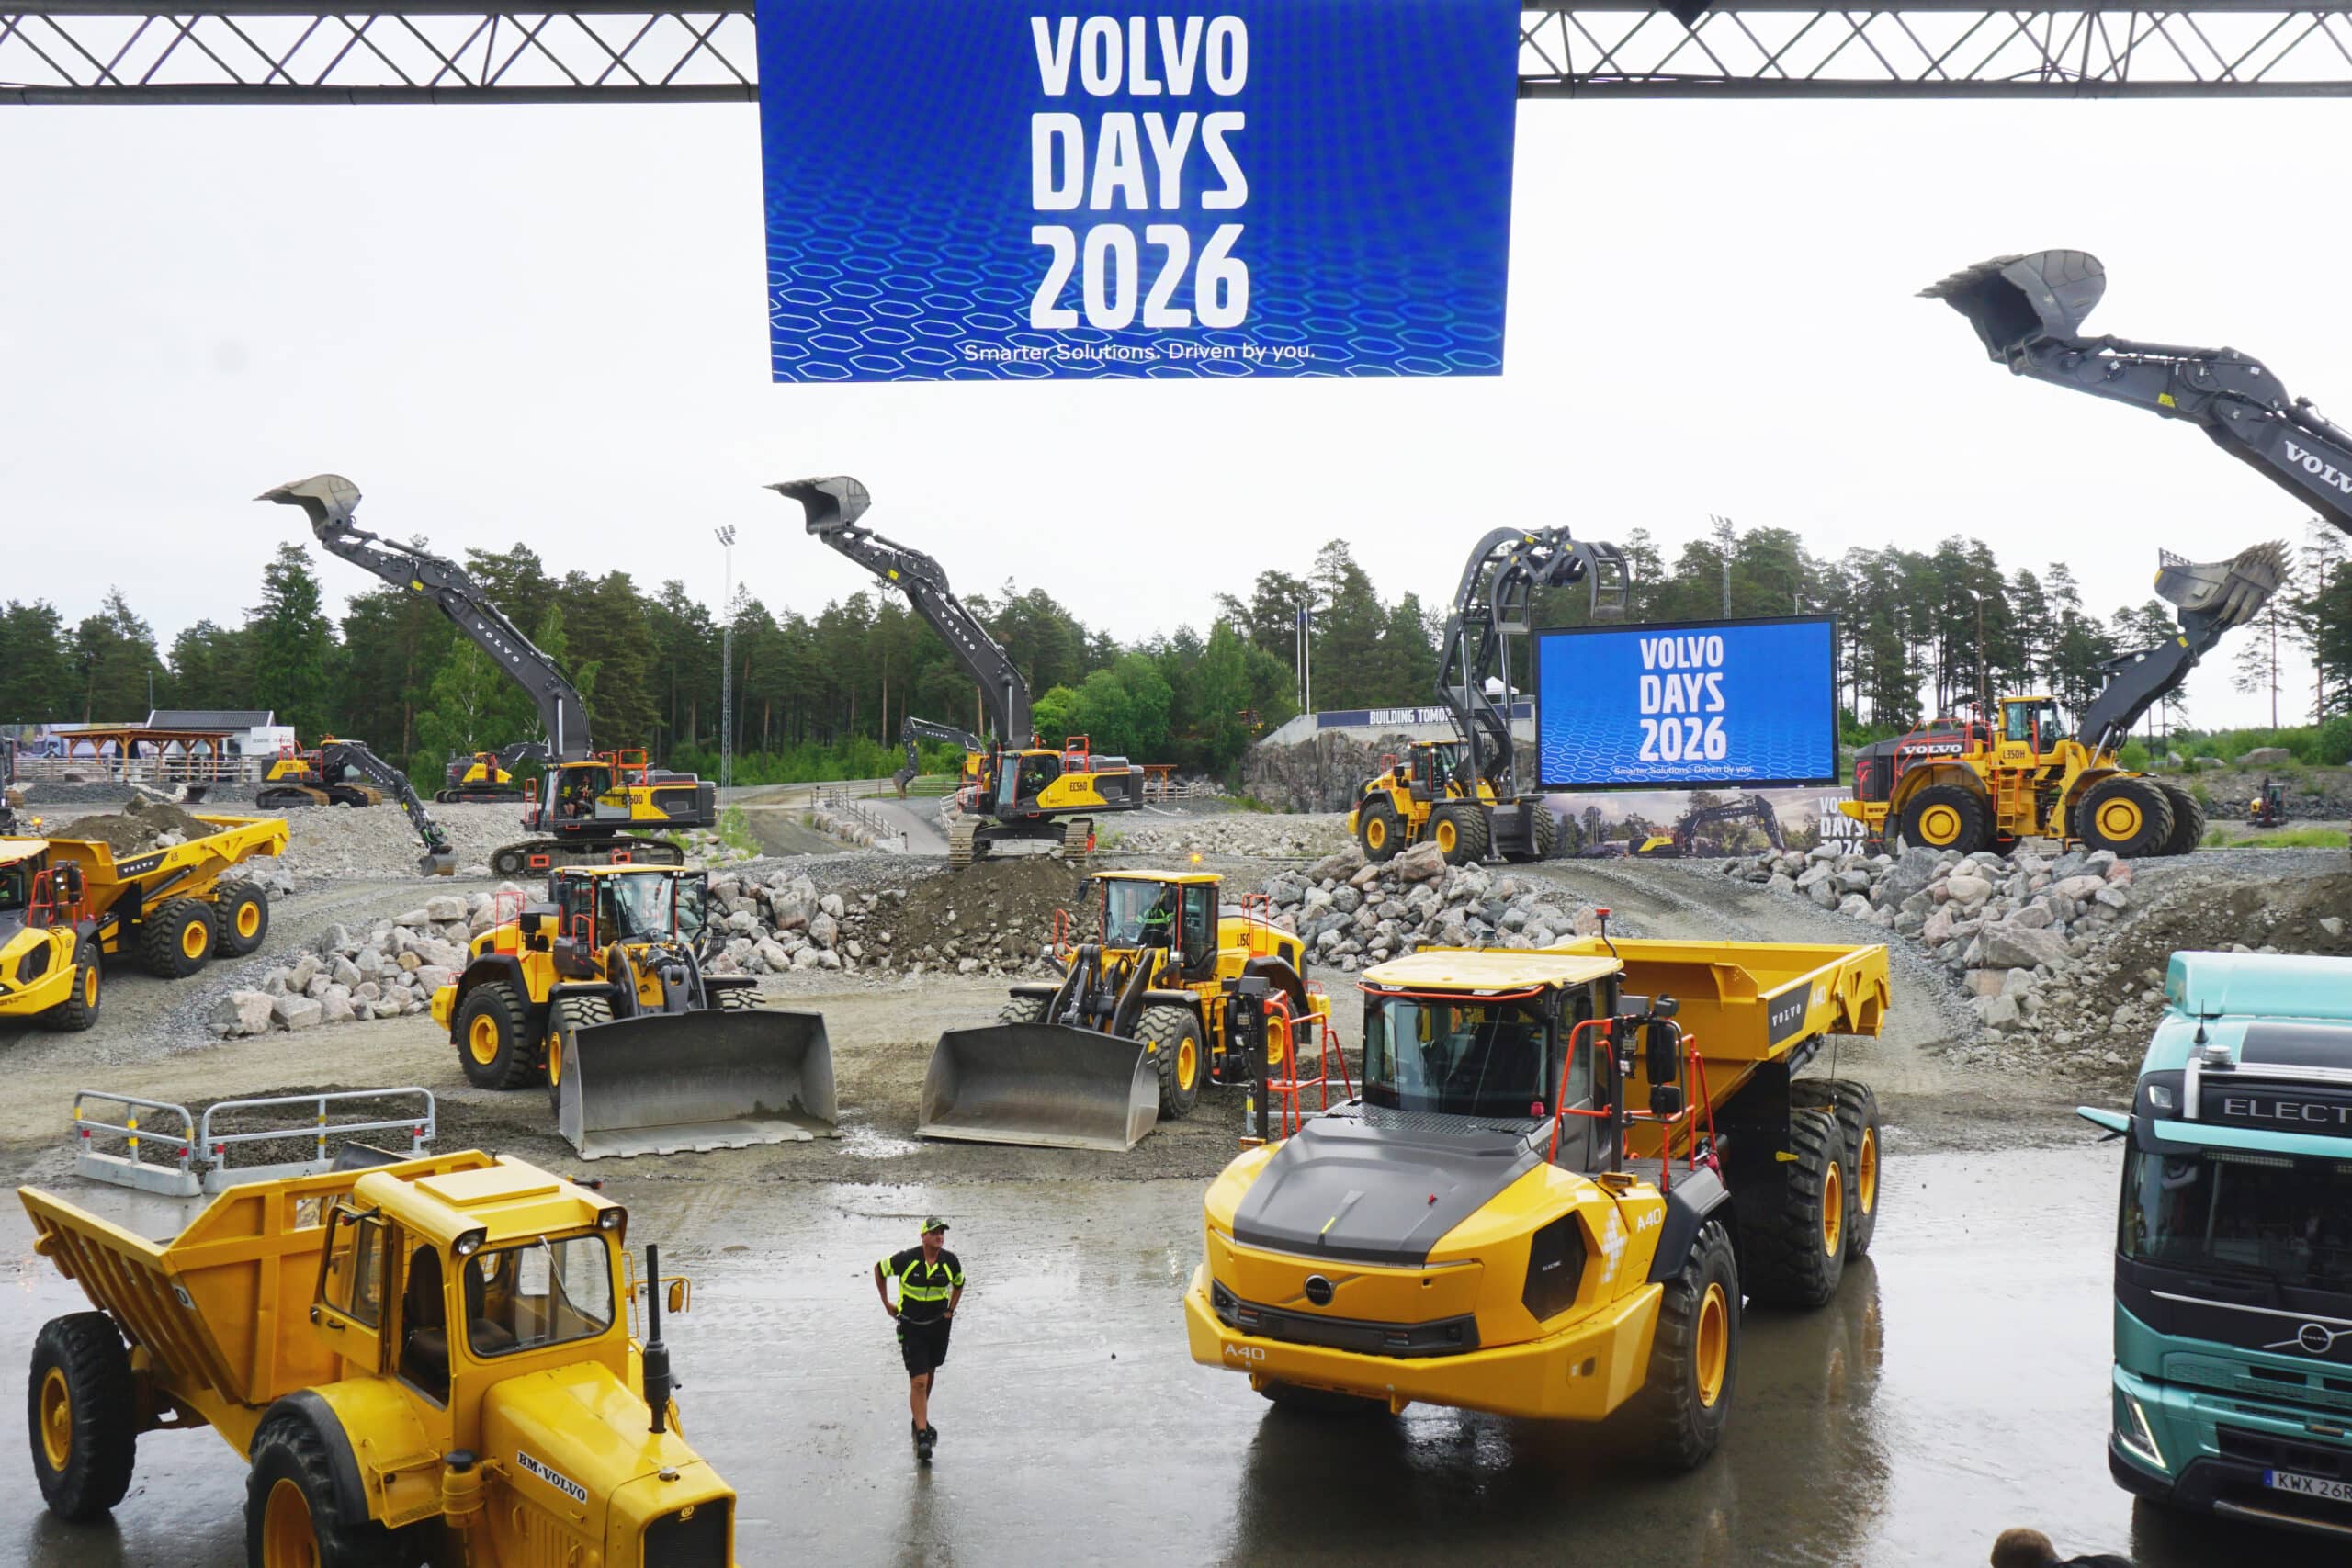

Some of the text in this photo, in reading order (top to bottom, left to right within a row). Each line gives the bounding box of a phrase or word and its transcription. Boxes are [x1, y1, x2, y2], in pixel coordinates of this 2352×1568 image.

[1030, 16, 1249, 96] VOLVO
[1031, 111, 1249, 211] DAYS
[1029, 223, 1250, 330] 2026
[964, 342, 1316, 365] Smarter Solutions. Driven by you.
[477, 622, 520, 662] VOLVO
[941, 611, 976, 650] VOLVO
[1640, 635, 1724, 670] VOLVO
[1640, 672, 1725, 714] DAYS
[1369, 709, 1414, 725] BUILDING
[1639, 716, 1727, 761] 2026
[1903, 744, 1962, 755] VOLVO
[2003, 749, 2025, 760] L350H
[1614, 766, 1648, 775] Smarter
[1694, 764, 1722, 773] Driven
[1723, 764, 1734, 774] by
[1772, 1003, 1801, 1027] VOLVO
[1637, 1208, 1662, 1234] A40
[1225, 1344, 1265, 1360] A40
[2278, 1472, 2313, 1494] KWX
